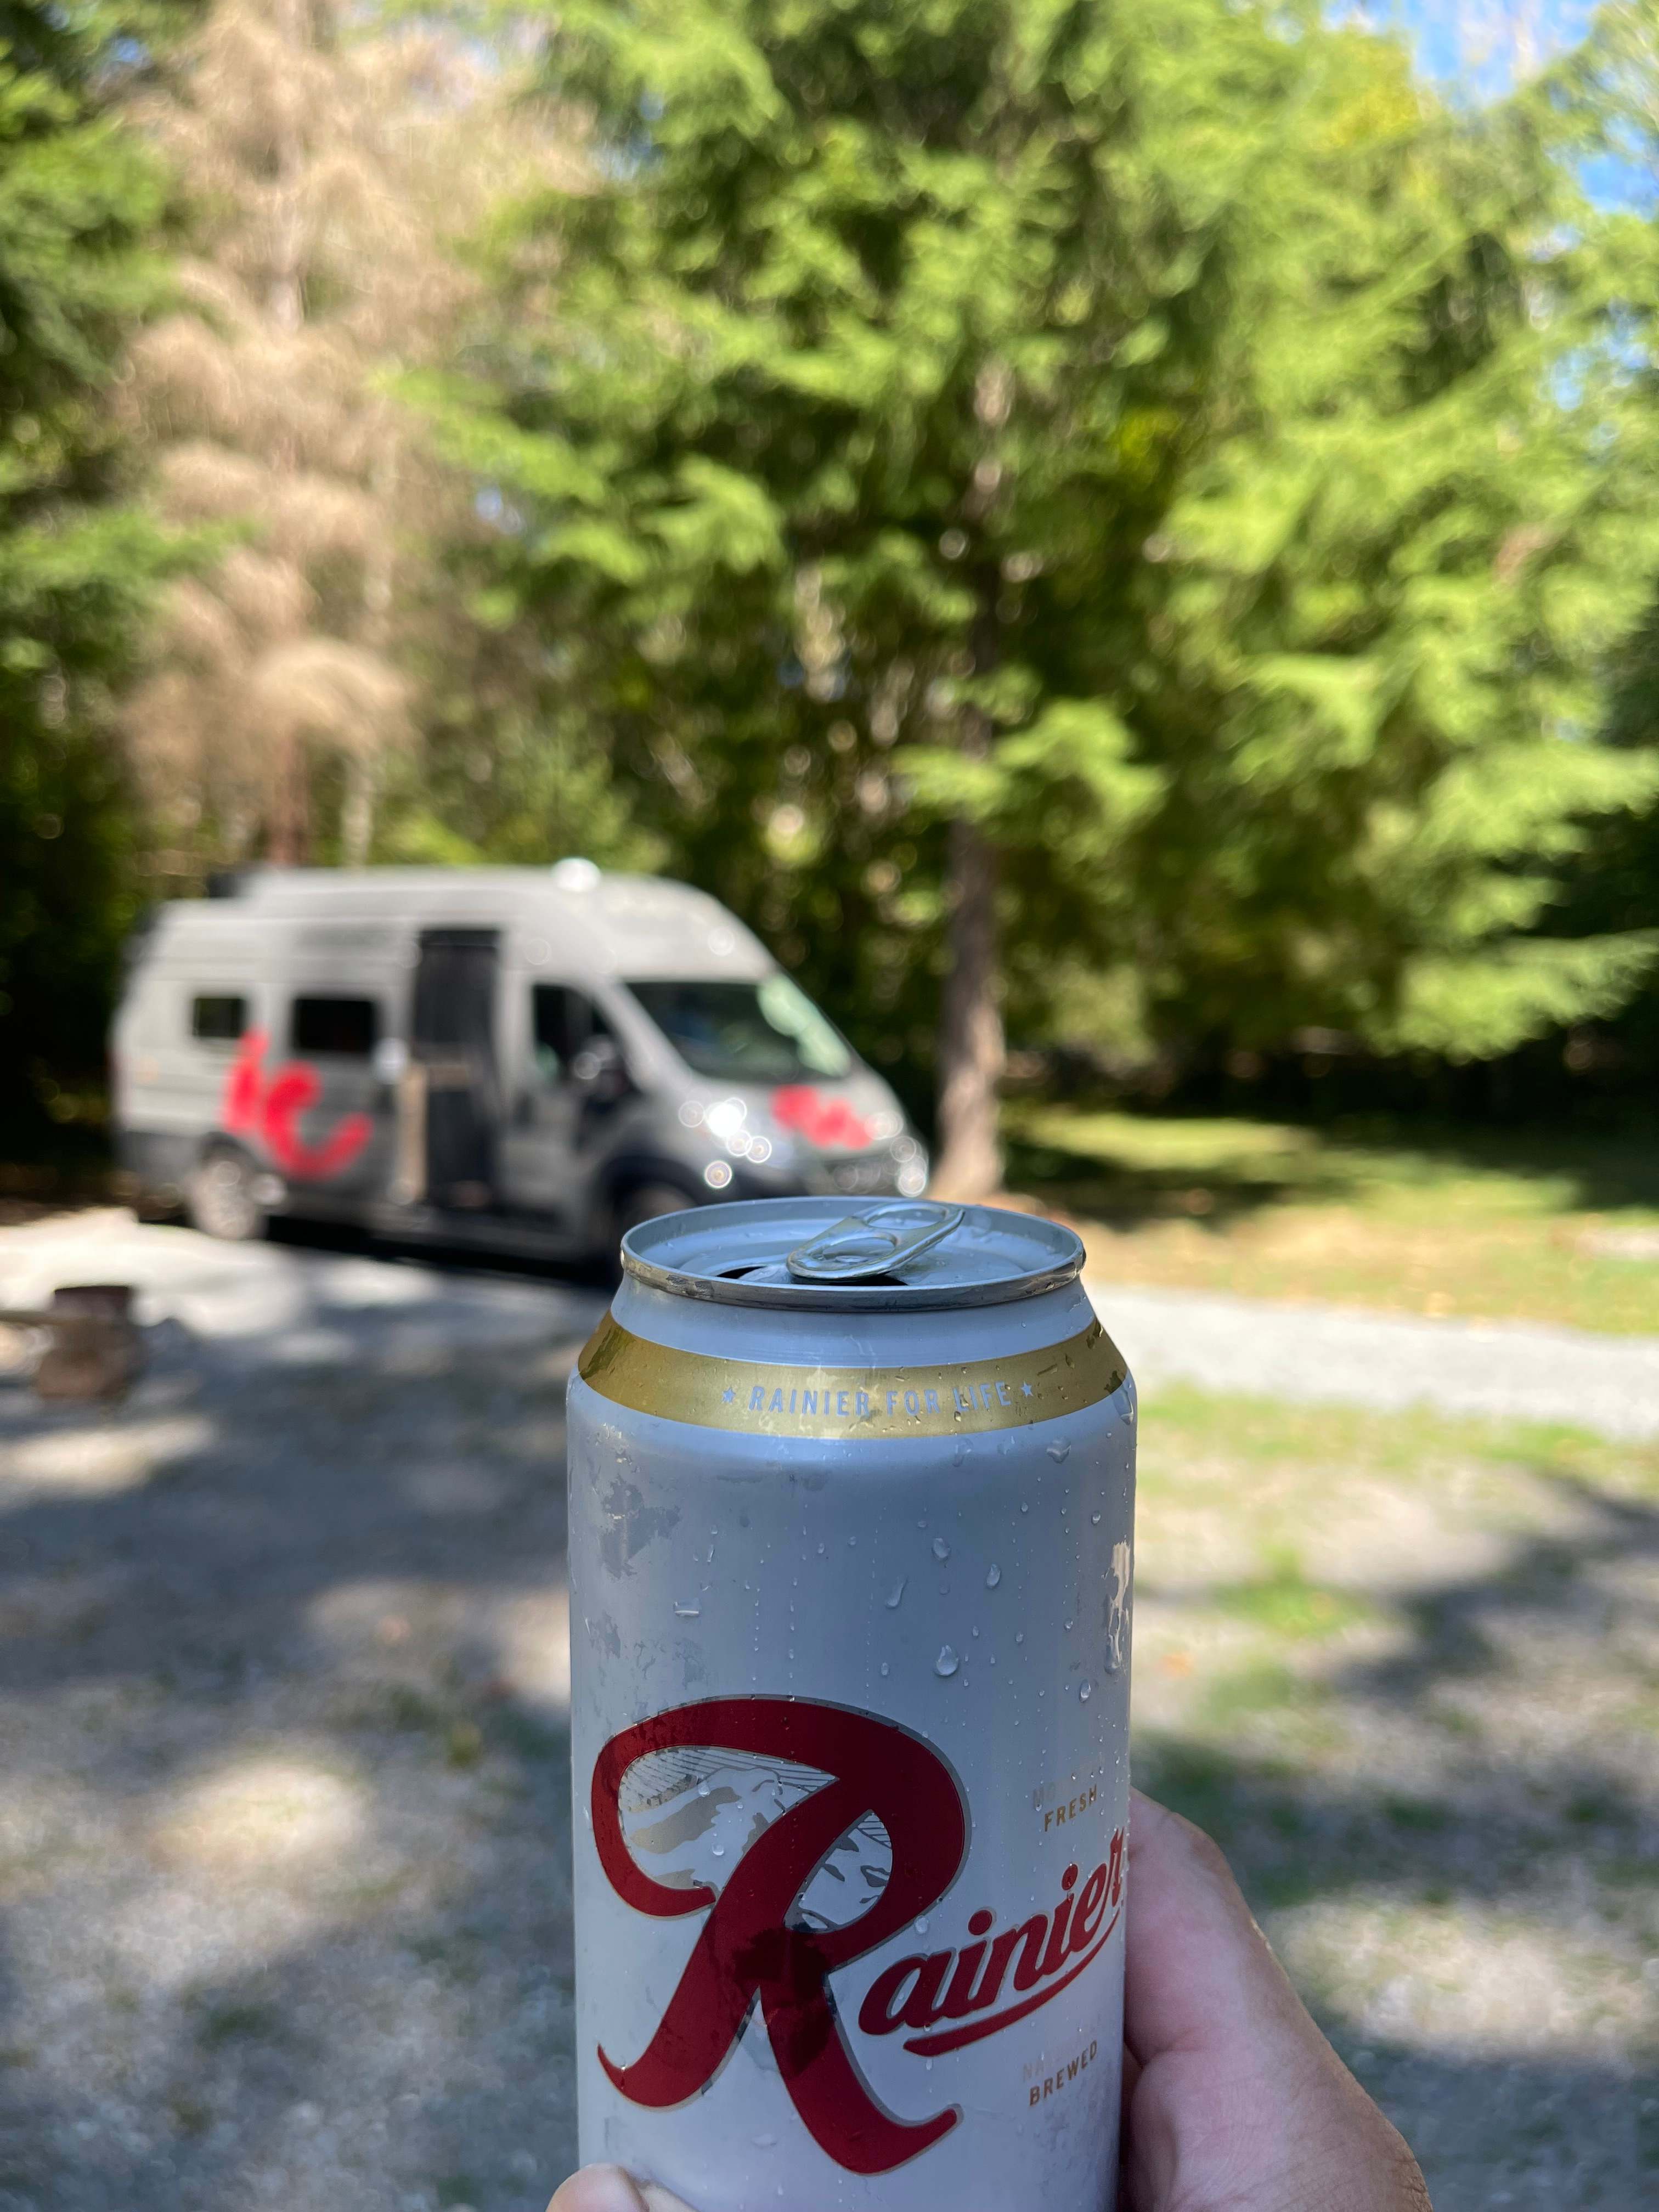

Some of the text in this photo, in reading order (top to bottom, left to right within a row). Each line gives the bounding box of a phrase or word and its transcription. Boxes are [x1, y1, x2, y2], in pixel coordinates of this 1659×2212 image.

[749, 1380, 1012, 1417] RAINIER FOR LIFE
[1044, 1784, 1097, 1832] FRESH
[1029, 2040, 1097, 2107] BREWED
